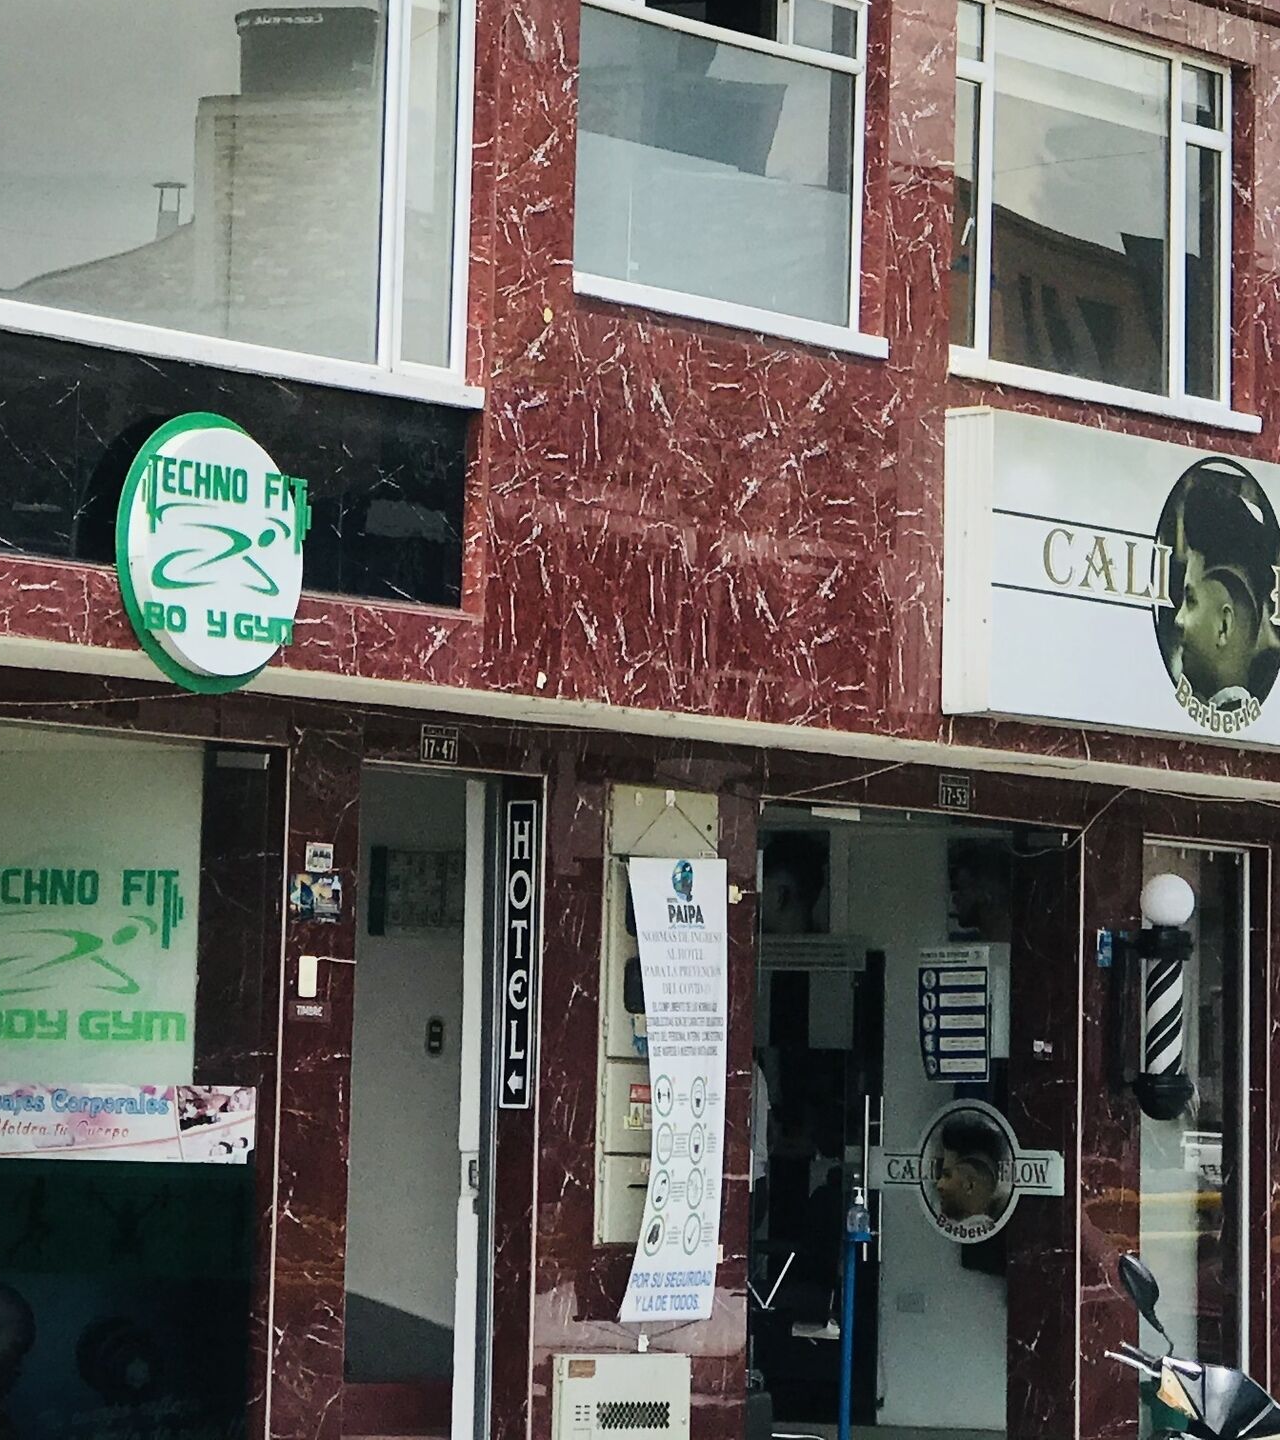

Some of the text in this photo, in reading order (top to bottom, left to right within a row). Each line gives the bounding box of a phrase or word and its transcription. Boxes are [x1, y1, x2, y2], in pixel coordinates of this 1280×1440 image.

[145, 453, 310, 550] TECHNO FIT
[1042, 527, 1175, 607] CALI
[234, 614, 294, 646] GYM
[122, 868, 180, 935] FIT
[508, 820, 531, 1060] HOTEL
[78, 1009, 187, 1042] GYM
[51, 1088, 170, 1117] Corporales
[77, 1119, 130, 1139] Cuerpo
[887, 1159, 1049, 1184] CALI FLOW
[630, 1270, 712, 1289] POR SU SEGURIDAD
[635, 1295, 642, 1312] Y
[642, 1295, 654, 1312] LA
[655, 1294, 669, 1311] DE
